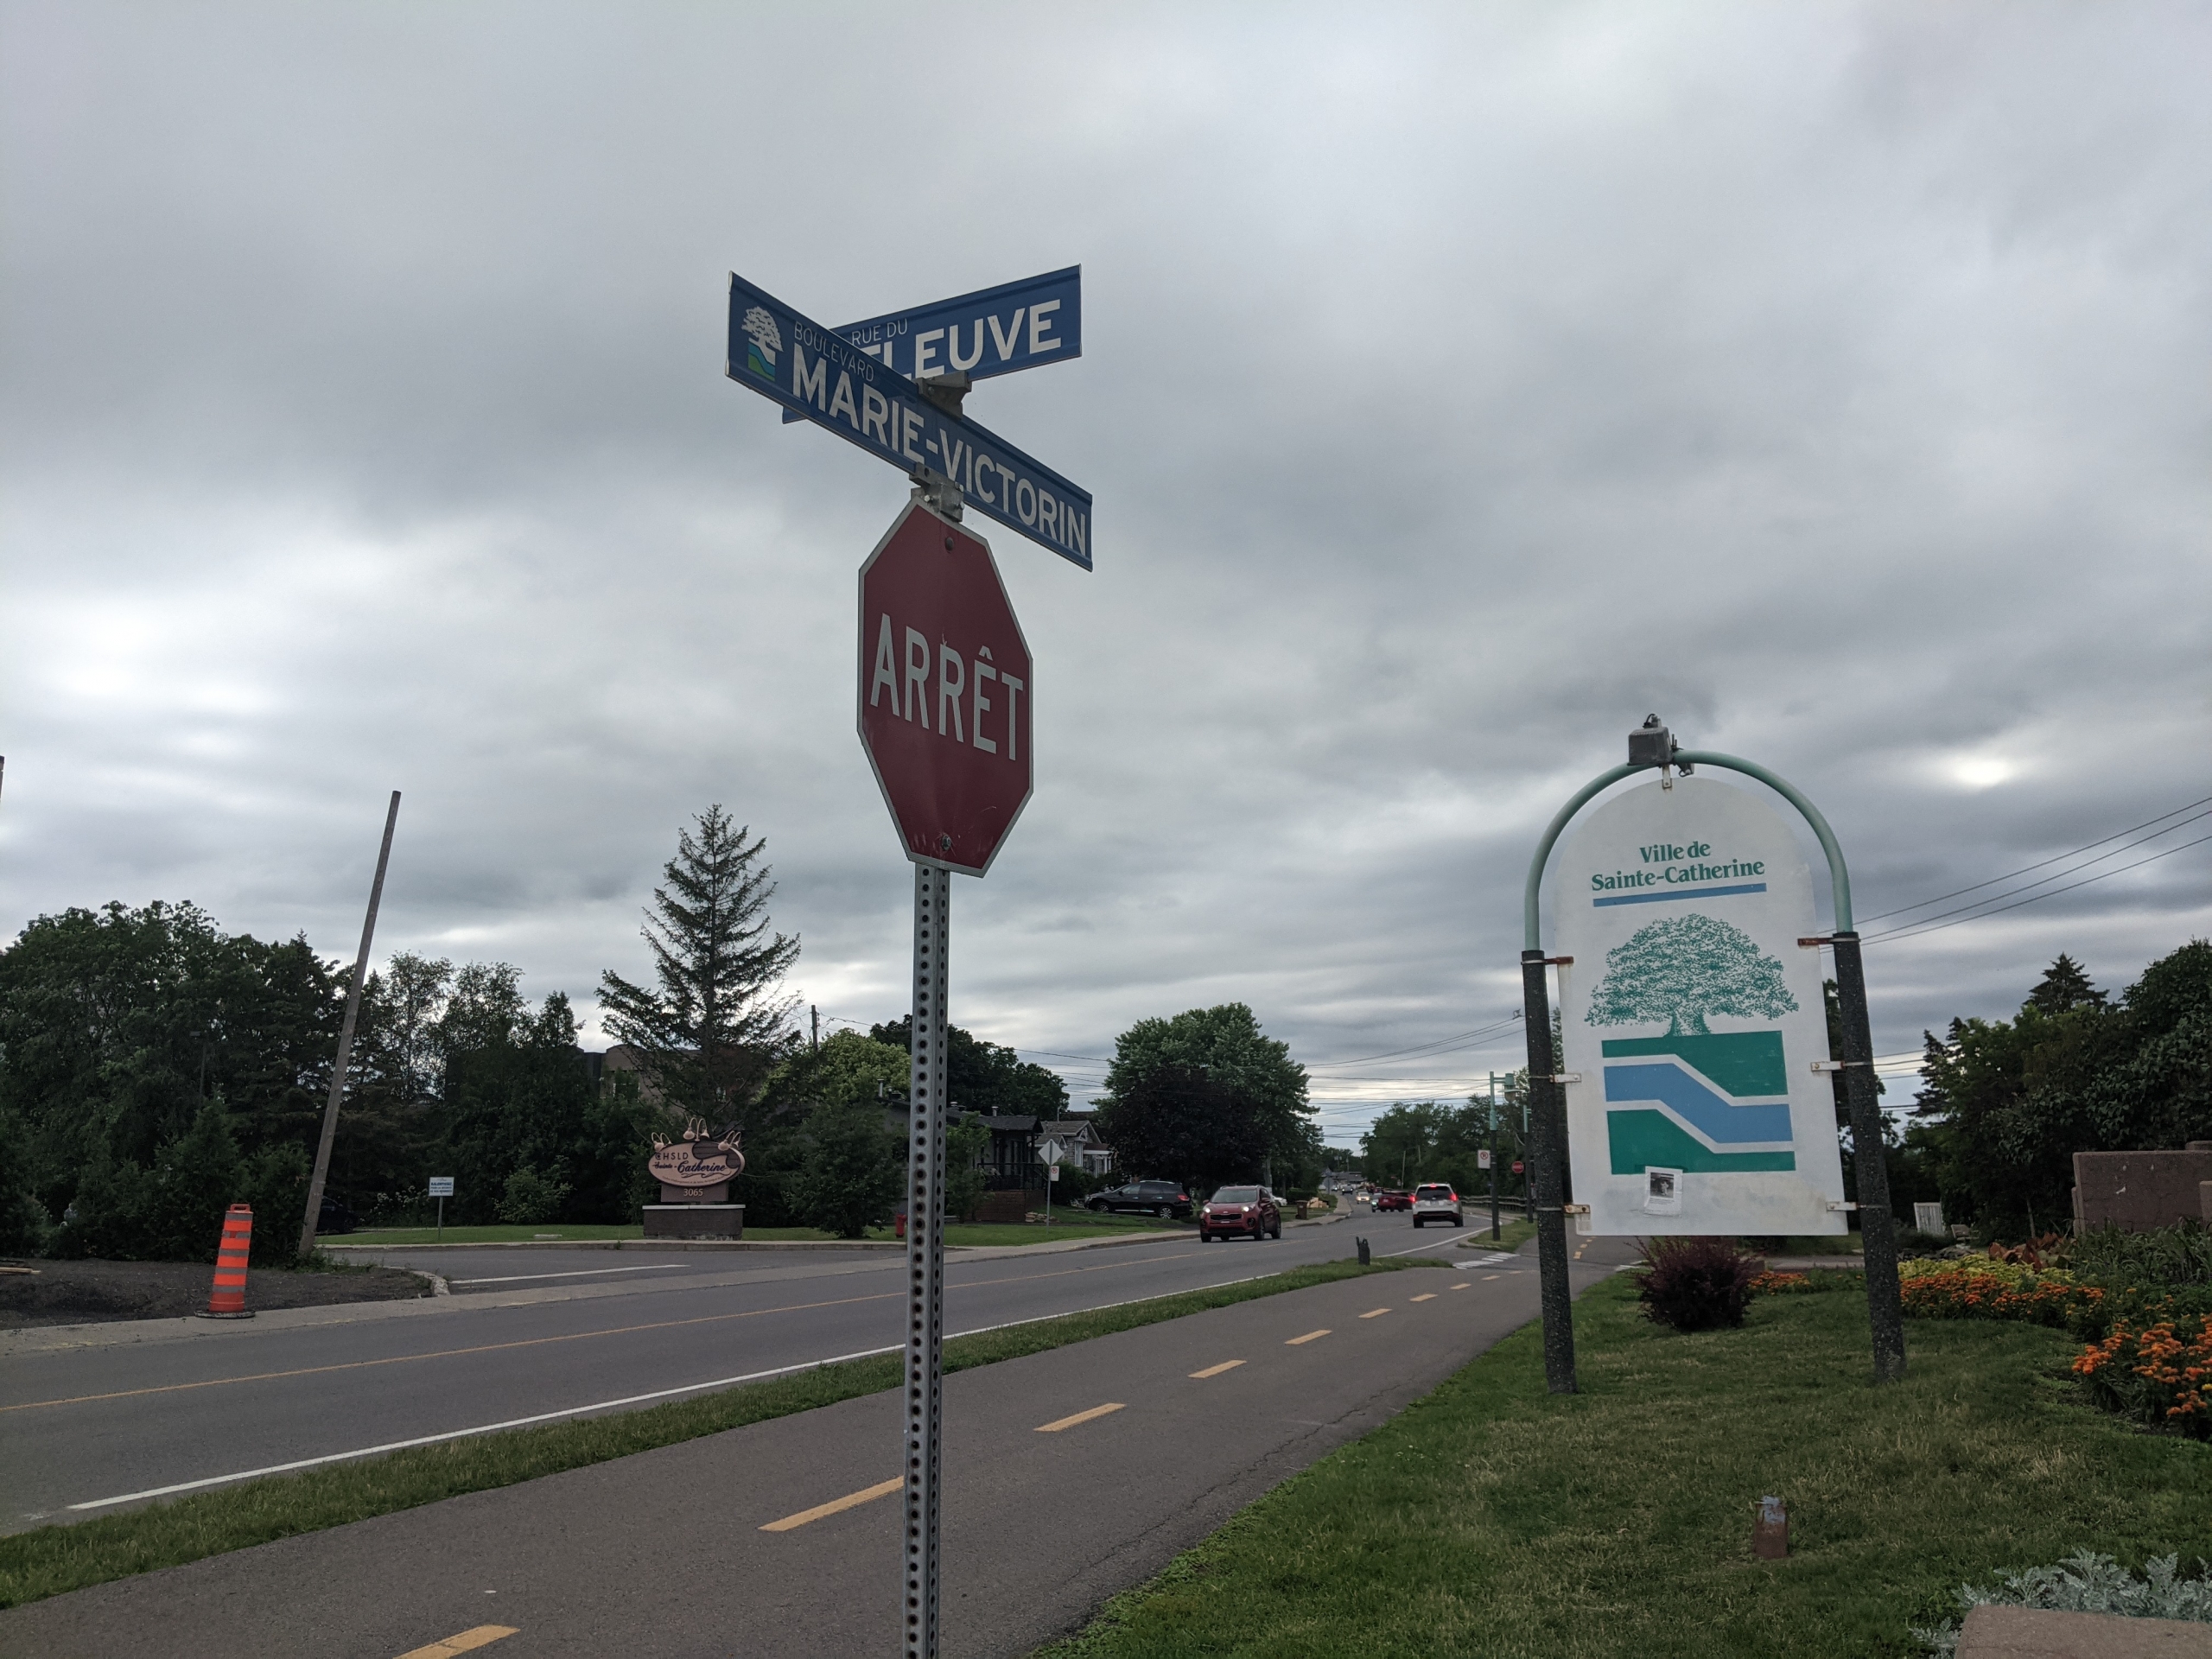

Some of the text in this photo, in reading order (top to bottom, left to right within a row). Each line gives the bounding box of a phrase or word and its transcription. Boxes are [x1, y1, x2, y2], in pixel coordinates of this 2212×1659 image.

[851, 318, 908, 346] RUE DU
[794, 321, 874, 382] BOULEVARD
[791, 342, 1087, 556] MARIE-VICTORIN
[869, 612, 1024, 761] ARRÊT
[1639, 841, 1711, 863] Ville de
[1592, 858, 1765, 891] Sainte-Catherine
[655, 1152, 689, 1160] CHSLD
[683, 1188, 703, 1197] 3065
